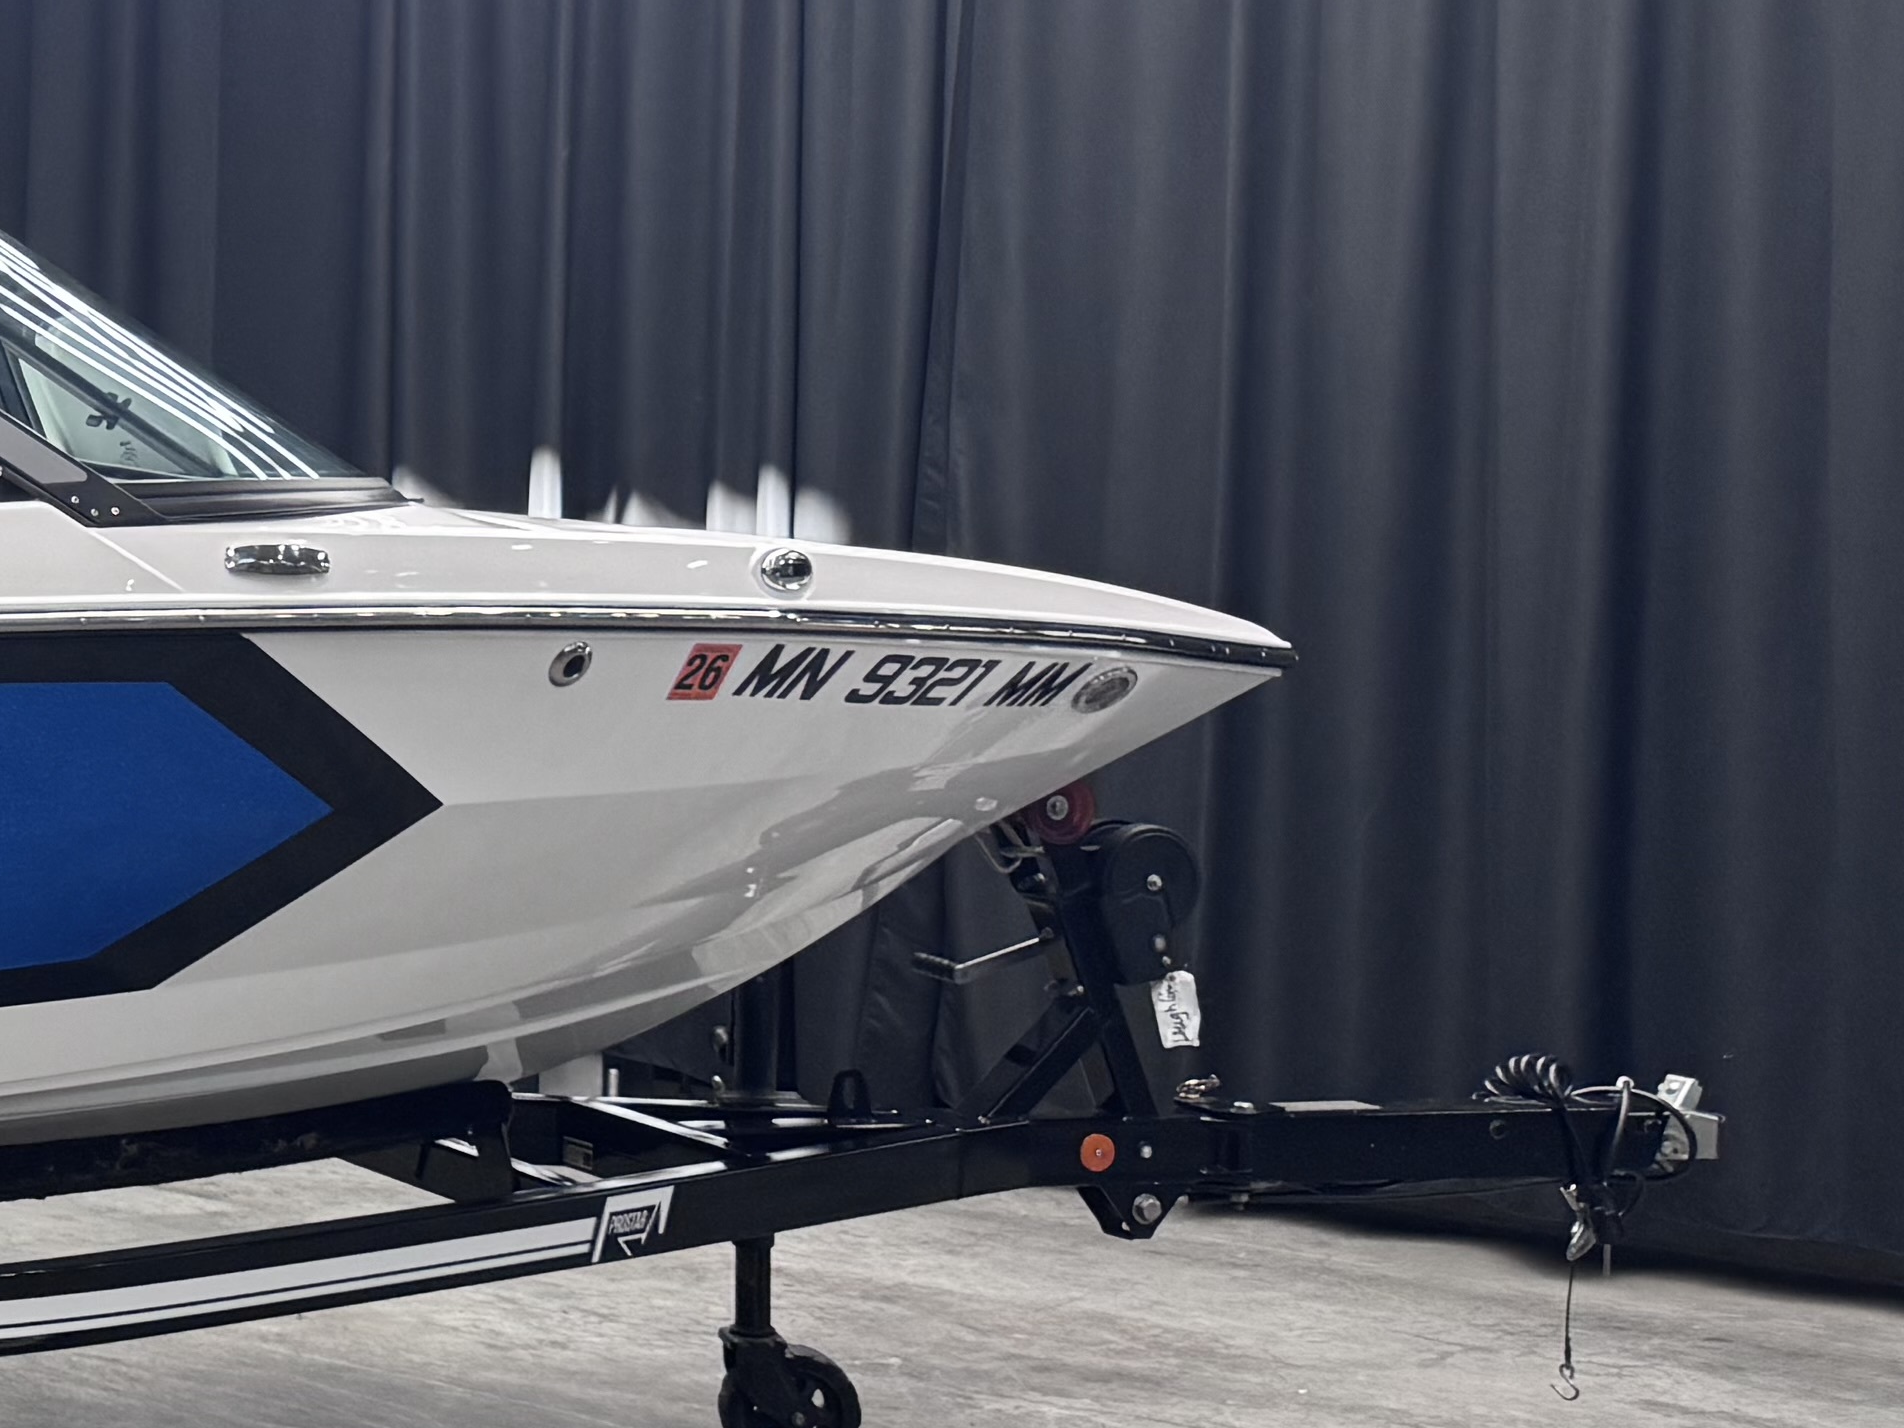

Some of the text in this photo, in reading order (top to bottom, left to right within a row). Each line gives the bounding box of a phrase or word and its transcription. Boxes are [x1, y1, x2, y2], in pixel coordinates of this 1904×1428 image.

[674, 653, 730, 691] 26
[732, 643, 1093, 707] MN 9321 MM
